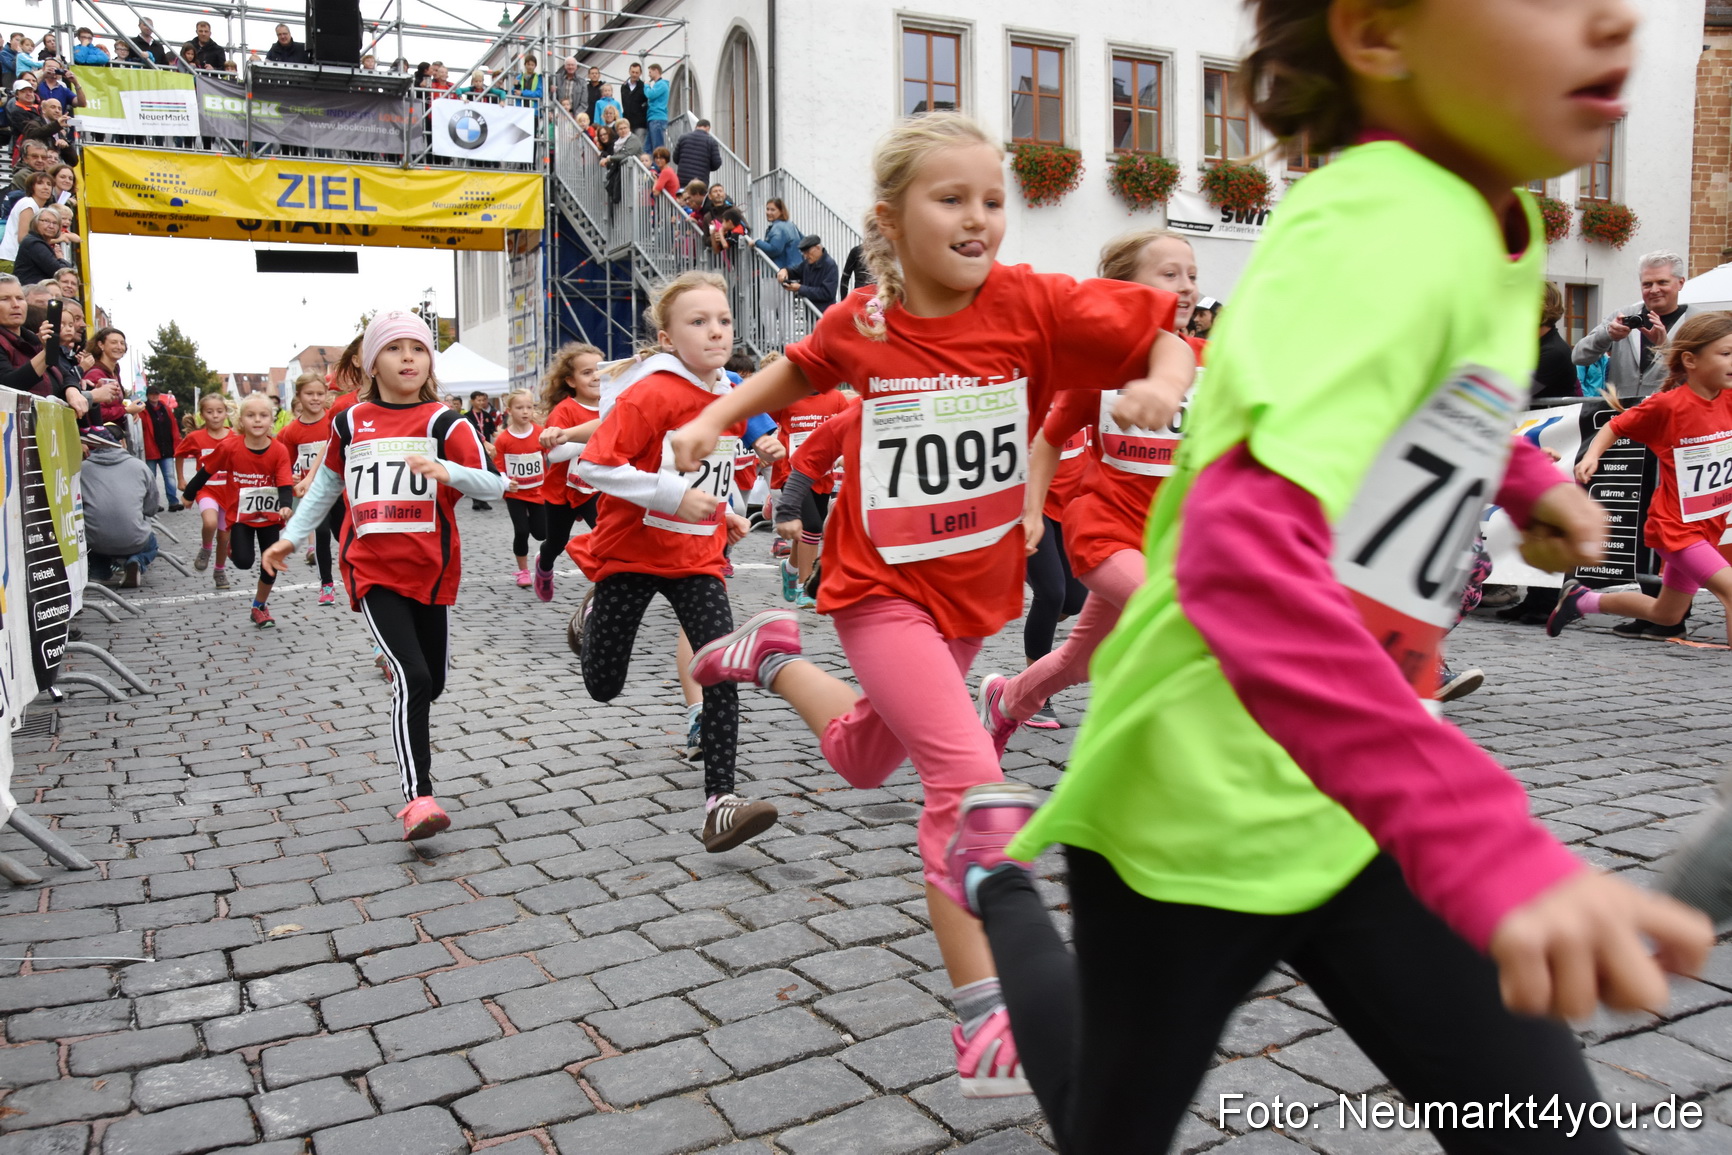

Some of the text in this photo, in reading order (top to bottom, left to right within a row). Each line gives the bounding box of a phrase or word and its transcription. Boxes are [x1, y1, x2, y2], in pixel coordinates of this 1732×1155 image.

[139, 113, 190, 122] NeuerMarkt
[289, 105, 325, 116] OFFICE
[309, 121, 400, 136] www.bockonline.de
[112, 180, 218, 197] Neumarkter Stadtlauf
[276, 173, 378, 212] ZIEL
[431, 202, 522, 211] Neumarkter Stadtlauf
[868, 373, 981, 393] Neumarkter
[872, 388, 1019, 426] NeuerMarkt BOCK
[378, 441, 428, 452] BOCK
[510, 460, 540, 476] 7098
[878, 423, 1017, 498] 7095
[1603, 463, 1628, 471] Wasser
[350, 461, 428, 500] 7170
[1600, 489, 1625, 498] Wärme
[930, 506, 977, 535] Leni
[32, 567, 56, 582] Freizeit
[1580, 566, 1624, 575] Parkhäuser
[37, 604, 70, 622] Stadtbusse
